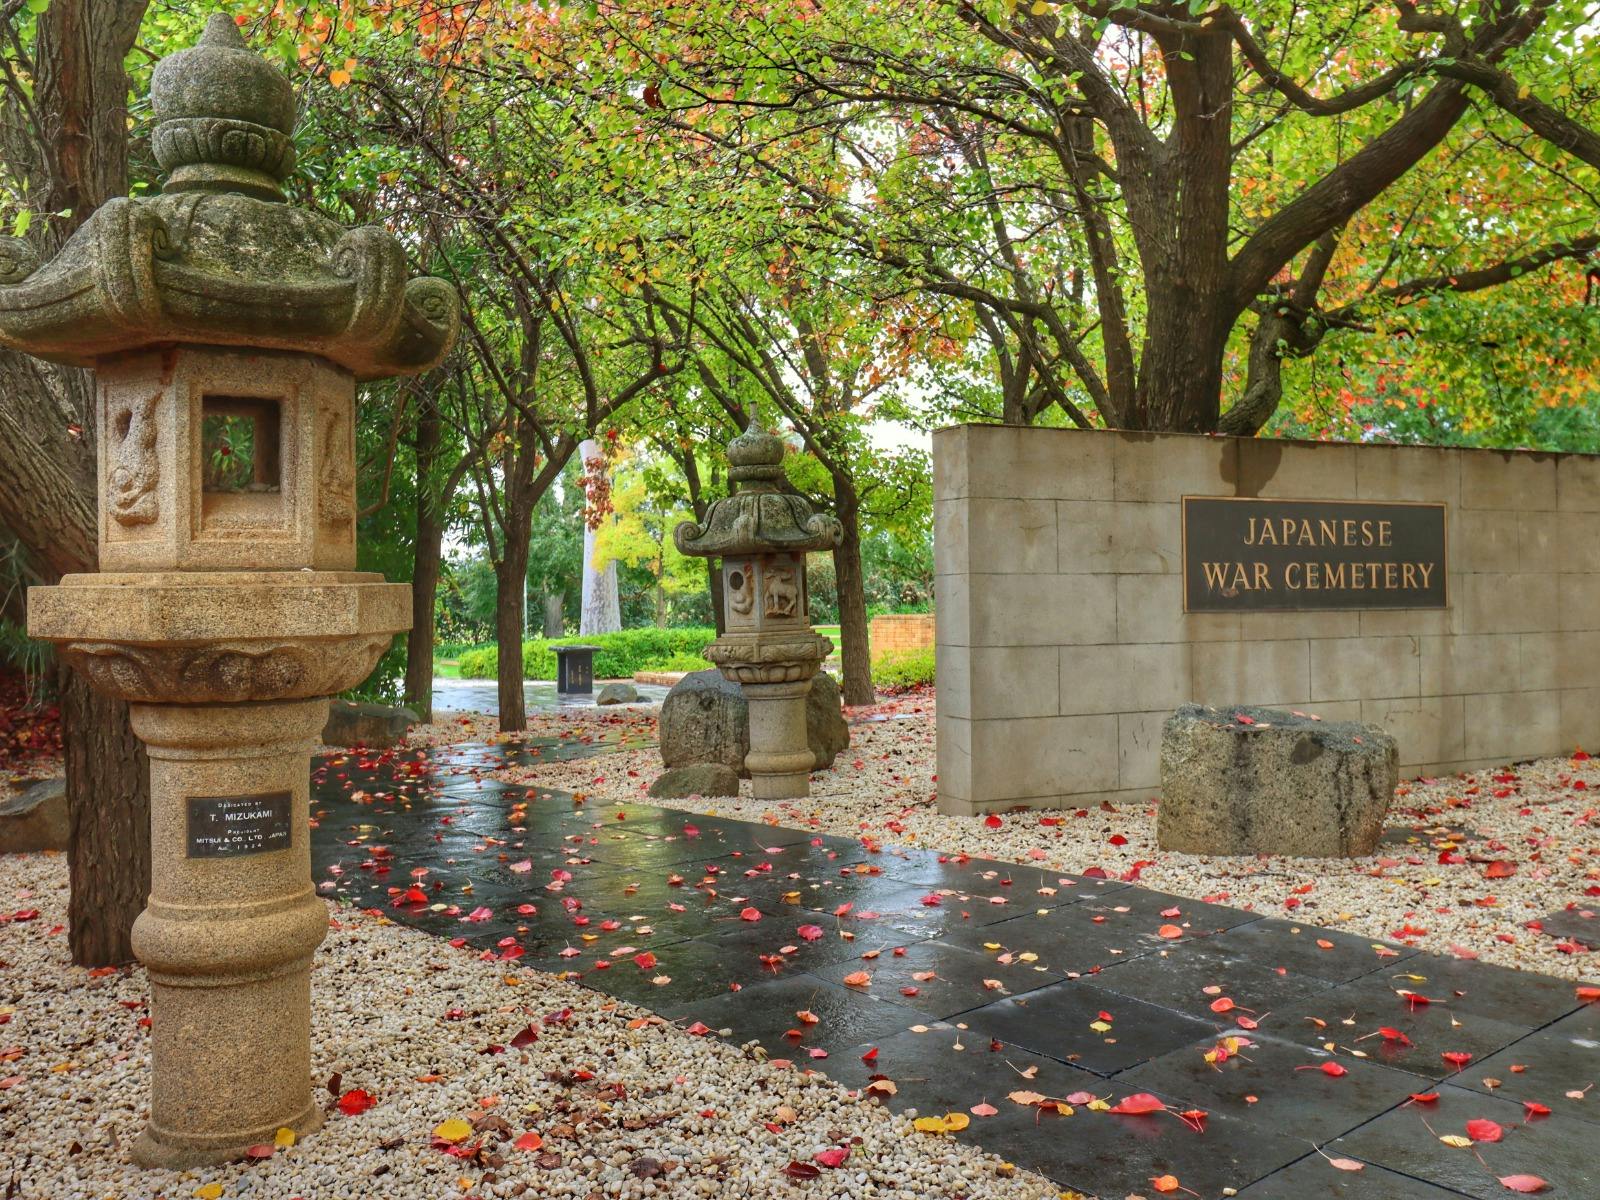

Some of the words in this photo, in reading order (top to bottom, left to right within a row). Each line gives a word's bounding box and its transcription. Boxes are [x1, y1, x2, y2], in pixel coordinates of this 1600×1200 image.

[1243, 517, 1393, 547] JAPANESE
[1202, 562, 1273, 590] WAR
[1284, 562, 1435, 590] CEMETERY
[209, 814, 218, 822] T.
[225, 810, 273, 821] MIZUKAMI
